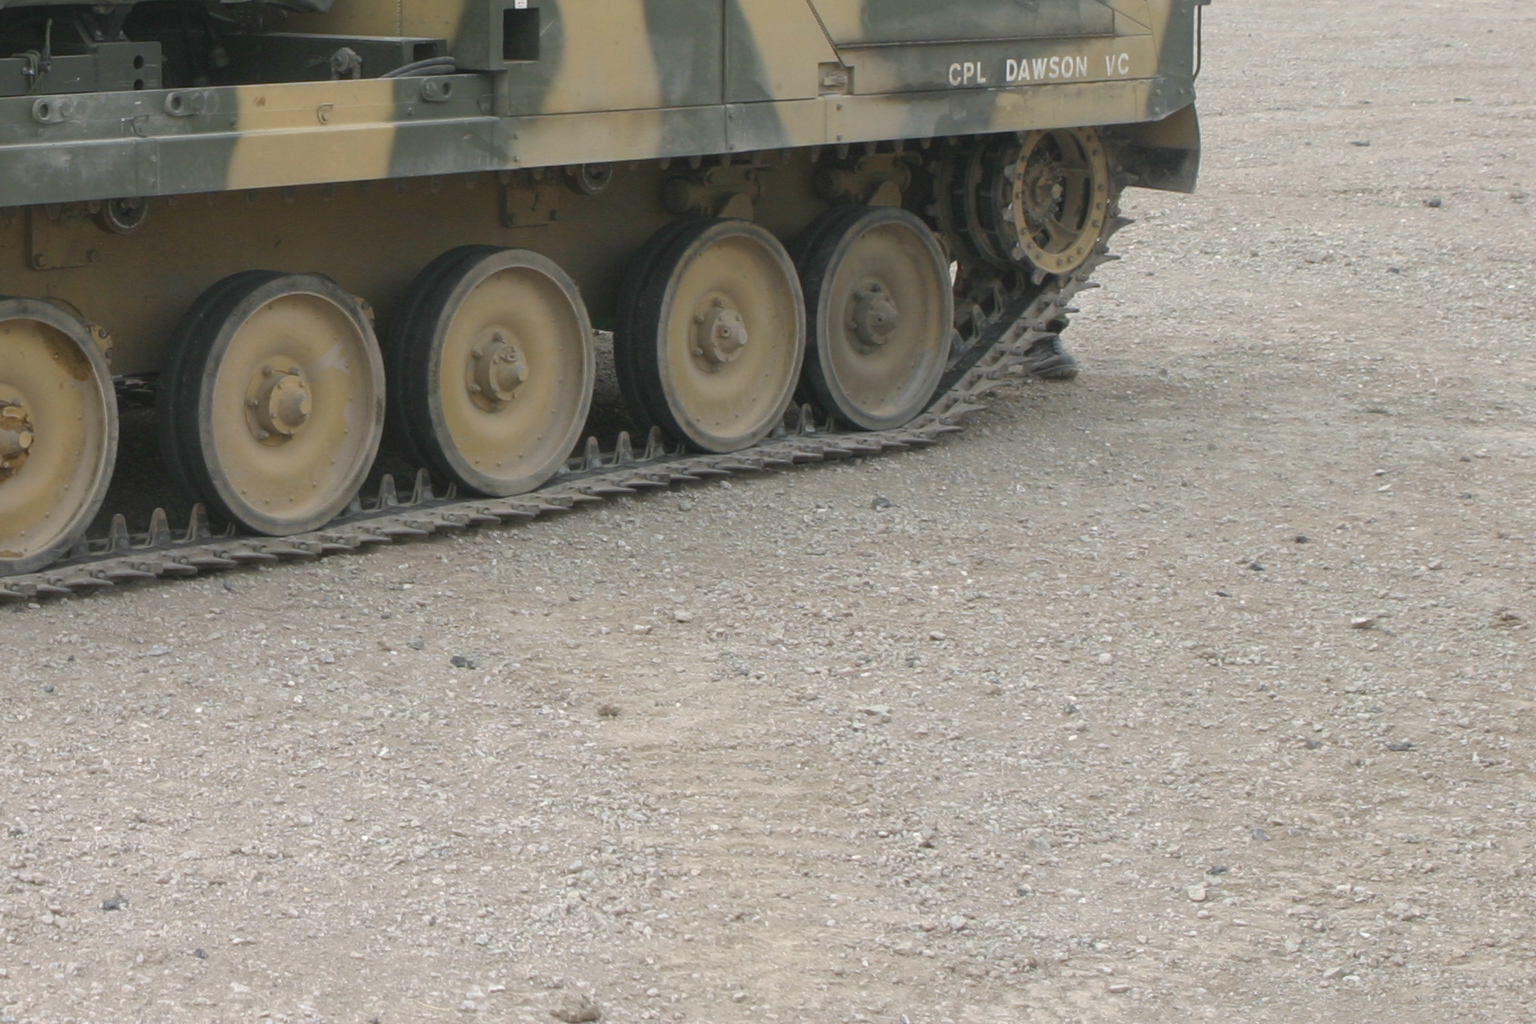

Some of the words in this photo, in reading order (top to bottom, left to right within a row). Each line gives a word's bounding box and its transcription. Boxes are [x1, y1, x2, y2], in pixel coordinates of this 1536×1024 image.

[948, 61, 987, 86] CPL
[1005, 55, 1089, 82] DAWSON
[1105, 52, 1130, 77] VC
